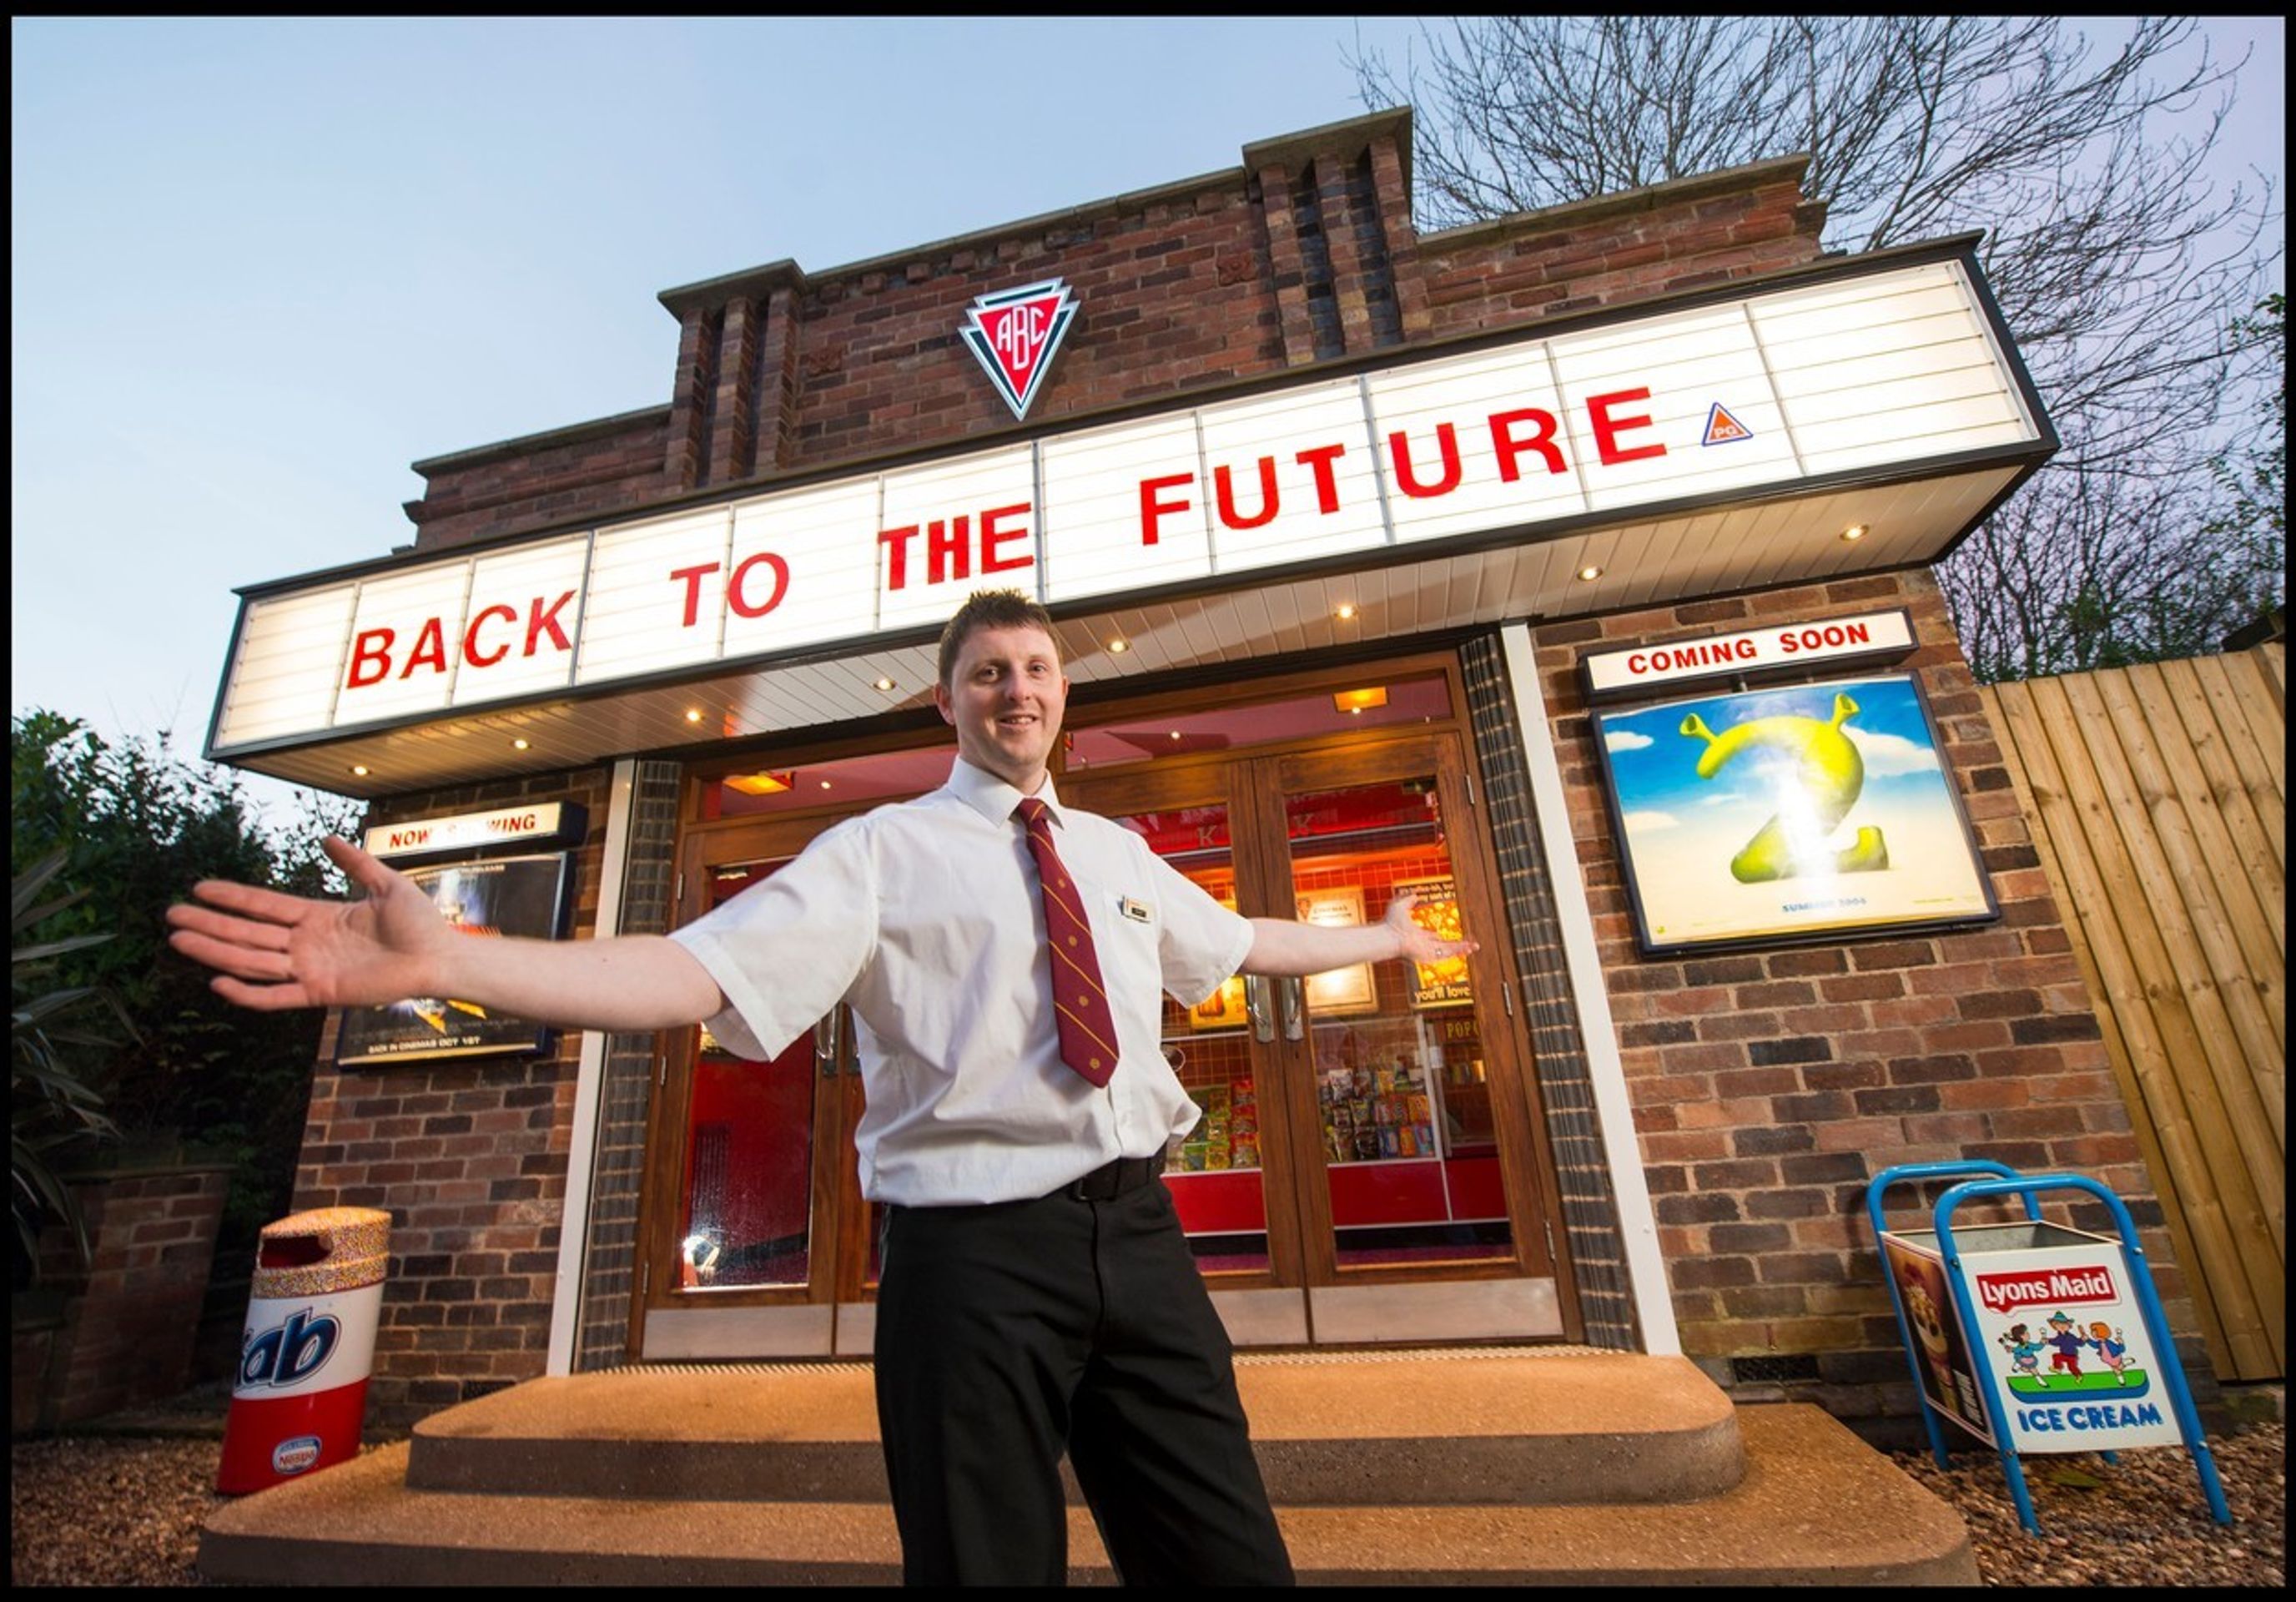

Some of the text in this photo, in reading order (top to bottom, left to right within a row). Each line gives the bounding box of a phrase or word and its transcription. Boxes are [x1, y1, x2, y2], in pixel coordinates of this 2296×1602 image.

[996, 305, 1046, 371] ABC
[347, 386, 1667, 689] BACK TO THE FUTURE
[1627, 623, 1870, 675] COMING SOON
[390, 814, 536, 849] NOW WING
[1415, 985, 1471, 1003] you'll love
[1981, 1272, 2111, 1306] Lyons Maid
[237, 1306, 342, 1388] ab
[2017, 1402, 2164, 1433] ICE CREAM
